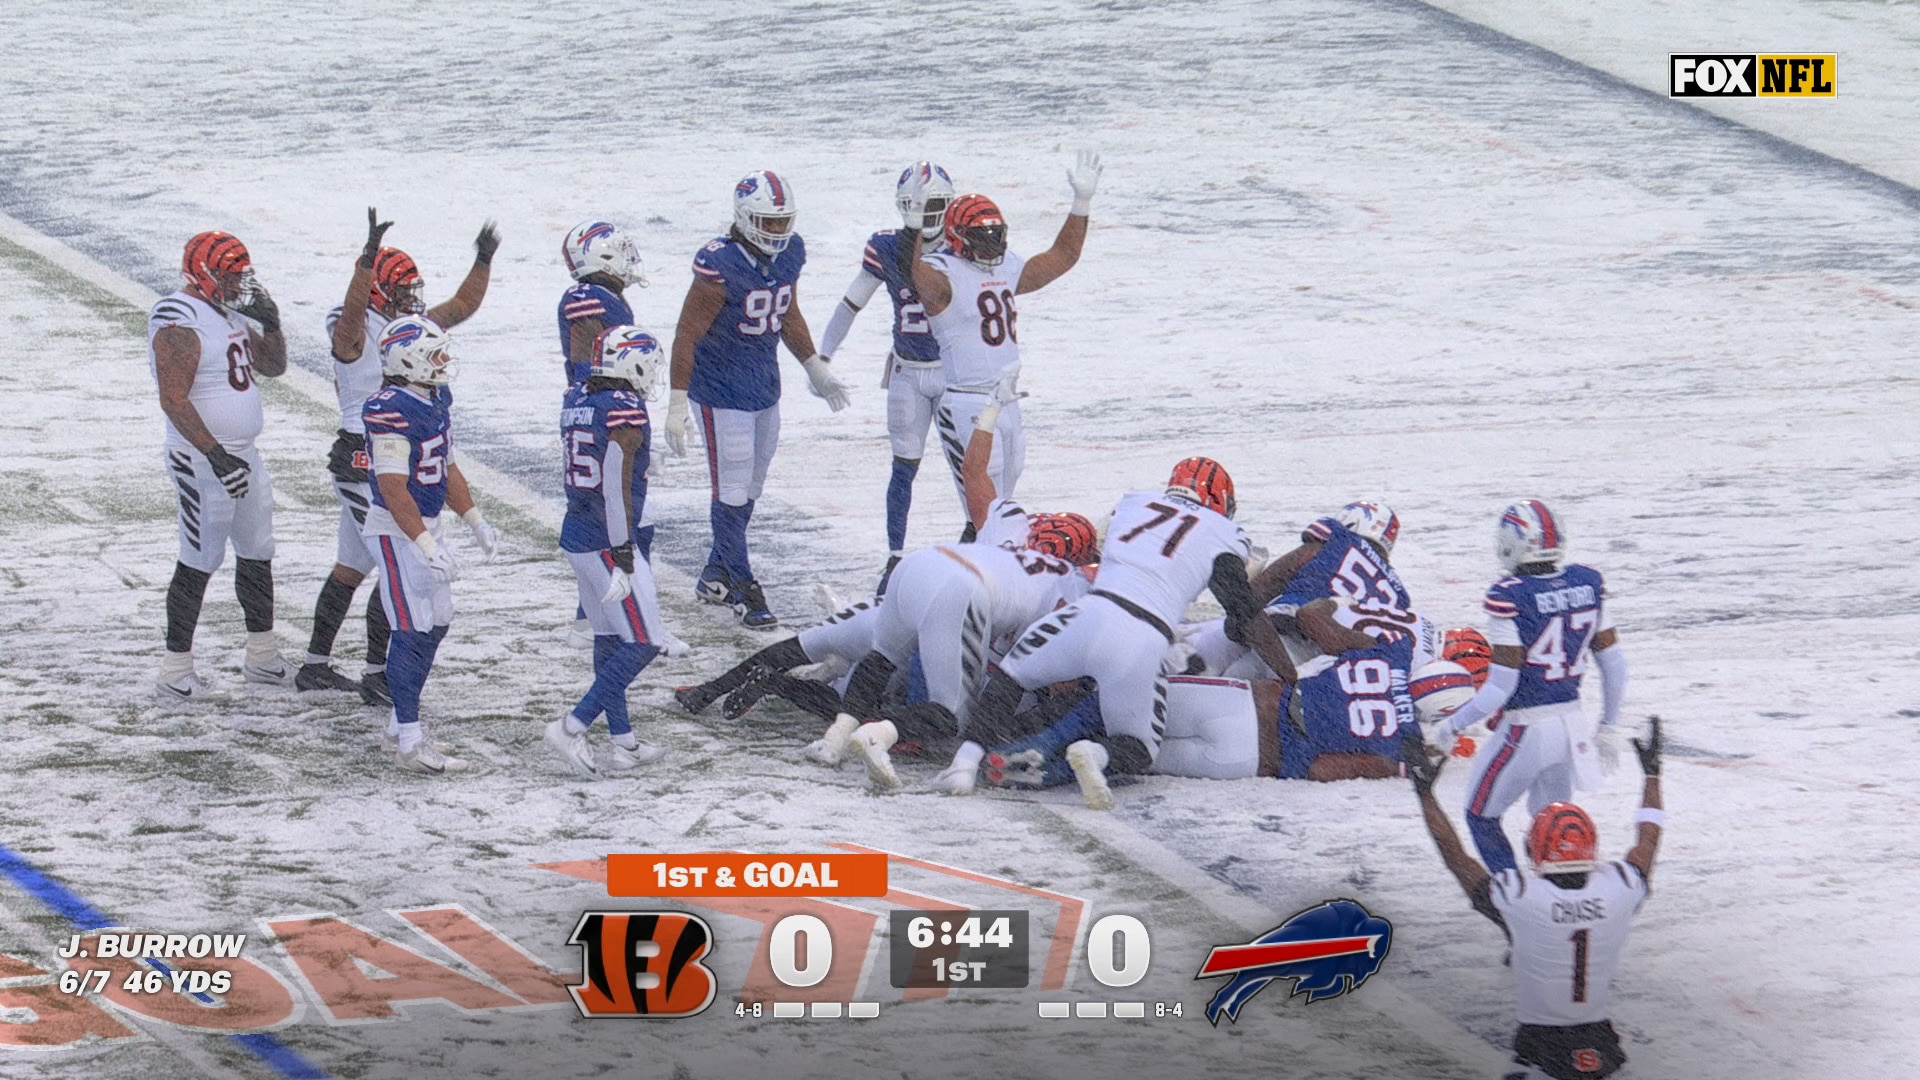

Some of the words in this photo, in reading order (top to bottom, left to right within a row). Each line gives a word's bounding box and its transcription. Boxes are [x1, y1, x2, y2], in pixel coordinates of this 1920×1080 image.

[736, 284, 792, 336] 98
[899, 287, 930, 334] 2
[416, 432, 449, 487] 5
[1117, 502, 1199, 558] 71
[1330, 546, 1409, 618] 53
[1534, 585, 1596, 614] BENFORD
[1526, 608, 1600, 682] 47
[1336, 657, 1399, 739] 96
[1391, 668, 1415, 724] WALKER
[1552, 898, 1607, 923] CHASE
[1569, 927, 1591, 1004] 1
